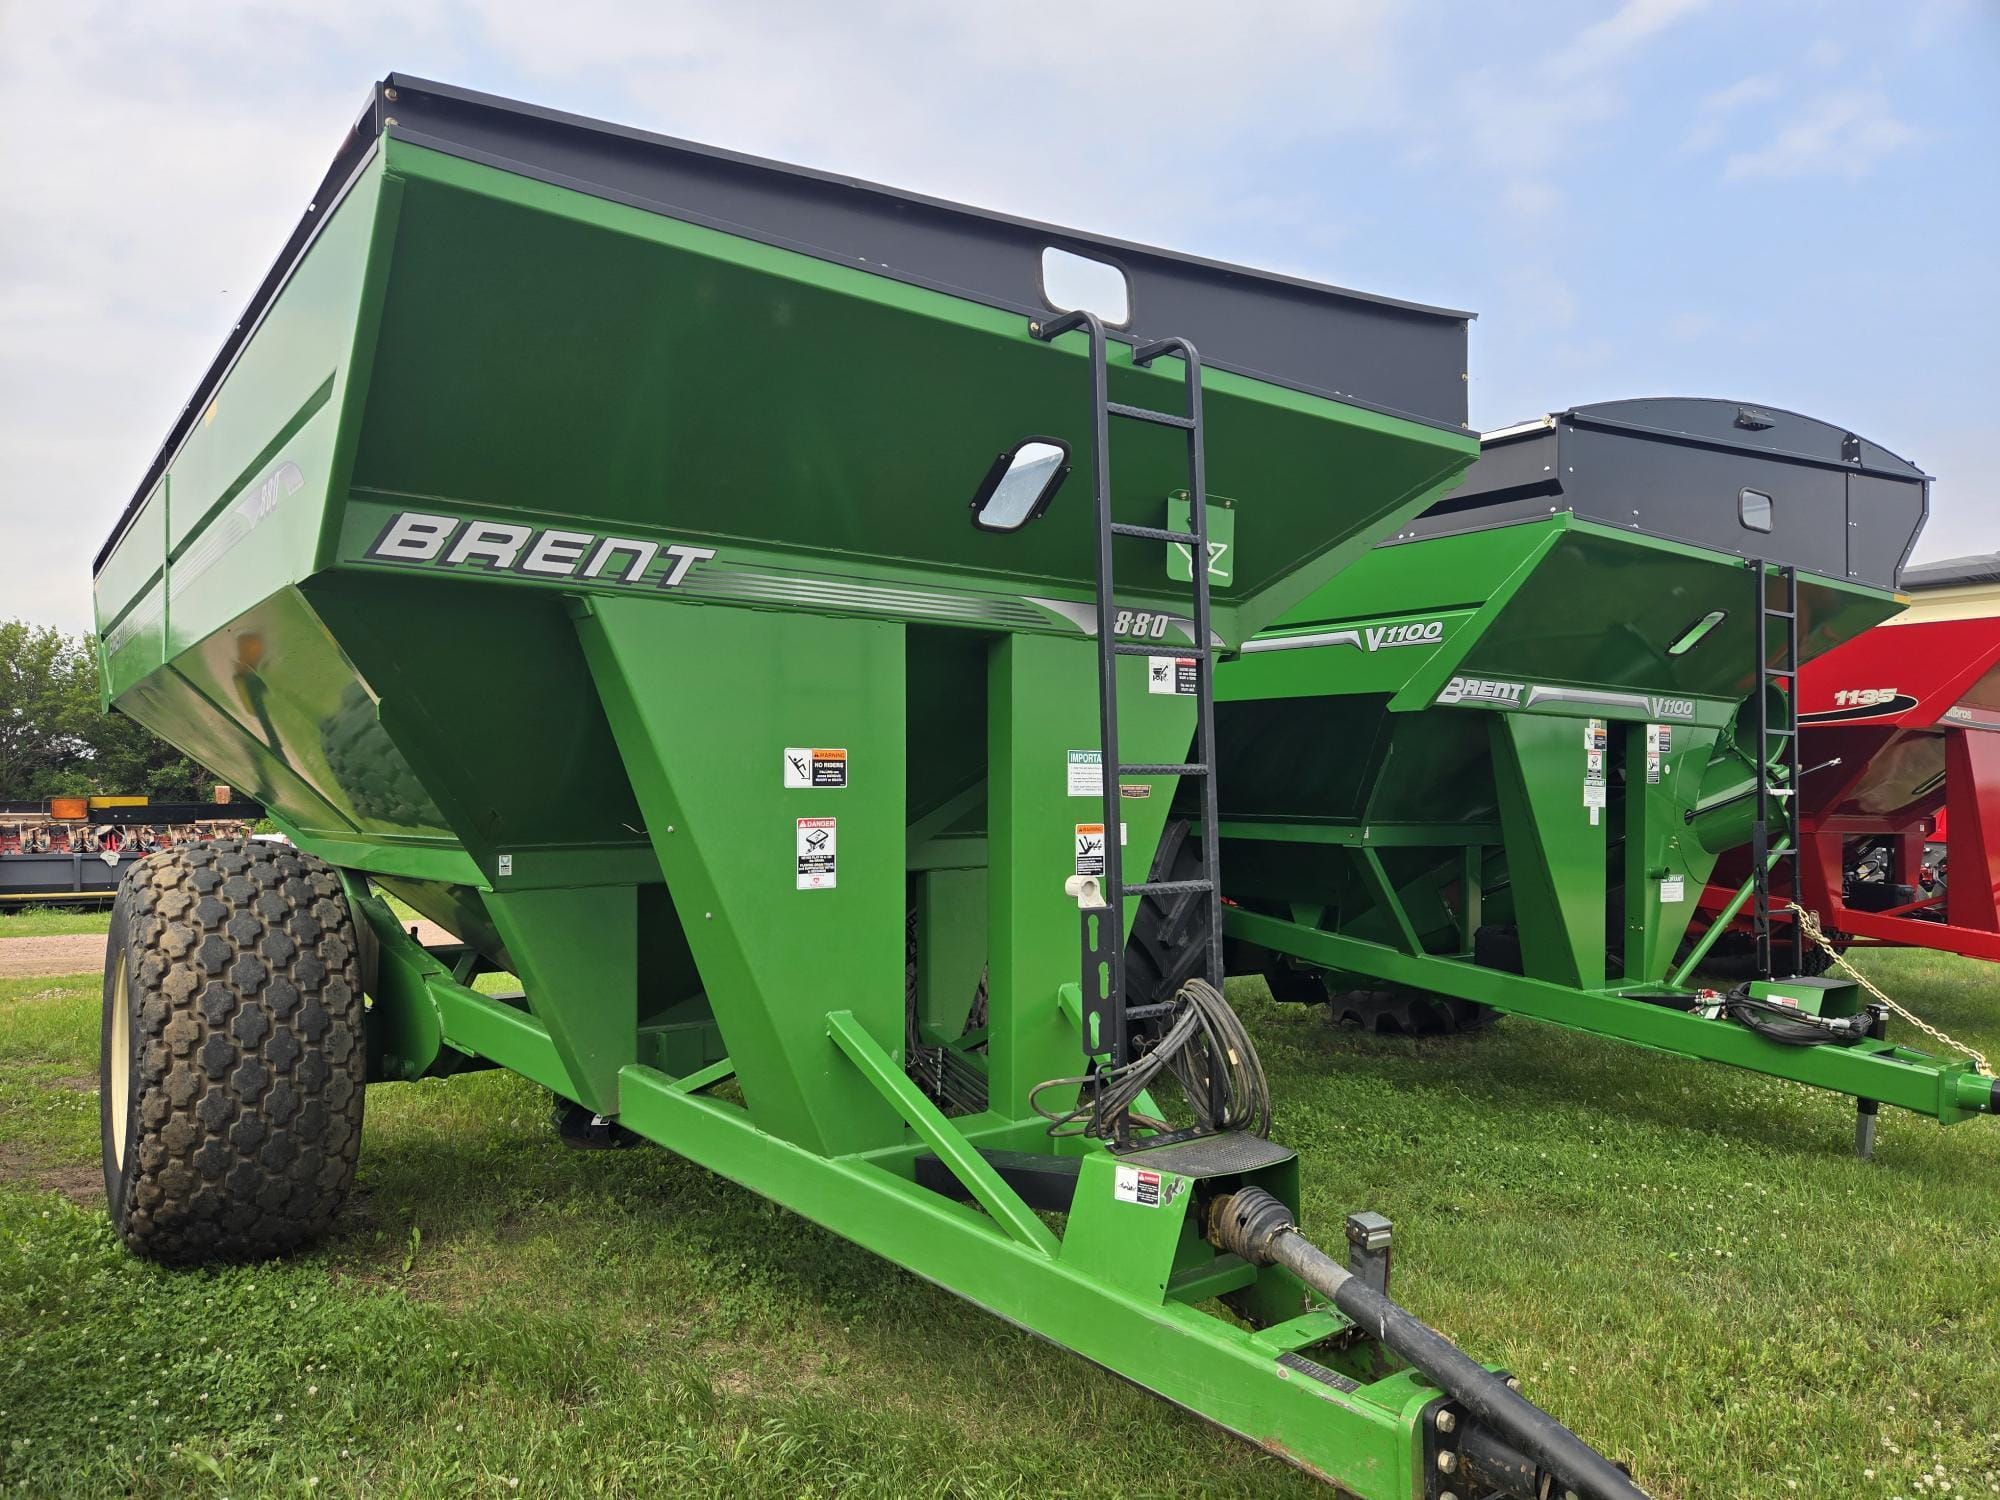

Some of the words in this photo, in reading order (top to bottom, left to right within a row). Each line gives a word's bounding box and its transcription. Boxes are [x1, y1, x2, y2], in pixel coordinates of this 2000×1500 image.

[364, 511, 718, 588] BRENT
[1113, 610, 1169, 638] 880
[1365, 621, 1443, 652] V1100
[1435, 676, 1525, 703] BRENT
[1834, 687, 1898, 706] 1135
[1651, 696, 1693, 718] V1100
[1070, 752, 1102, 764] IMPORTA
[806, 819, 835, 829] DANGER
